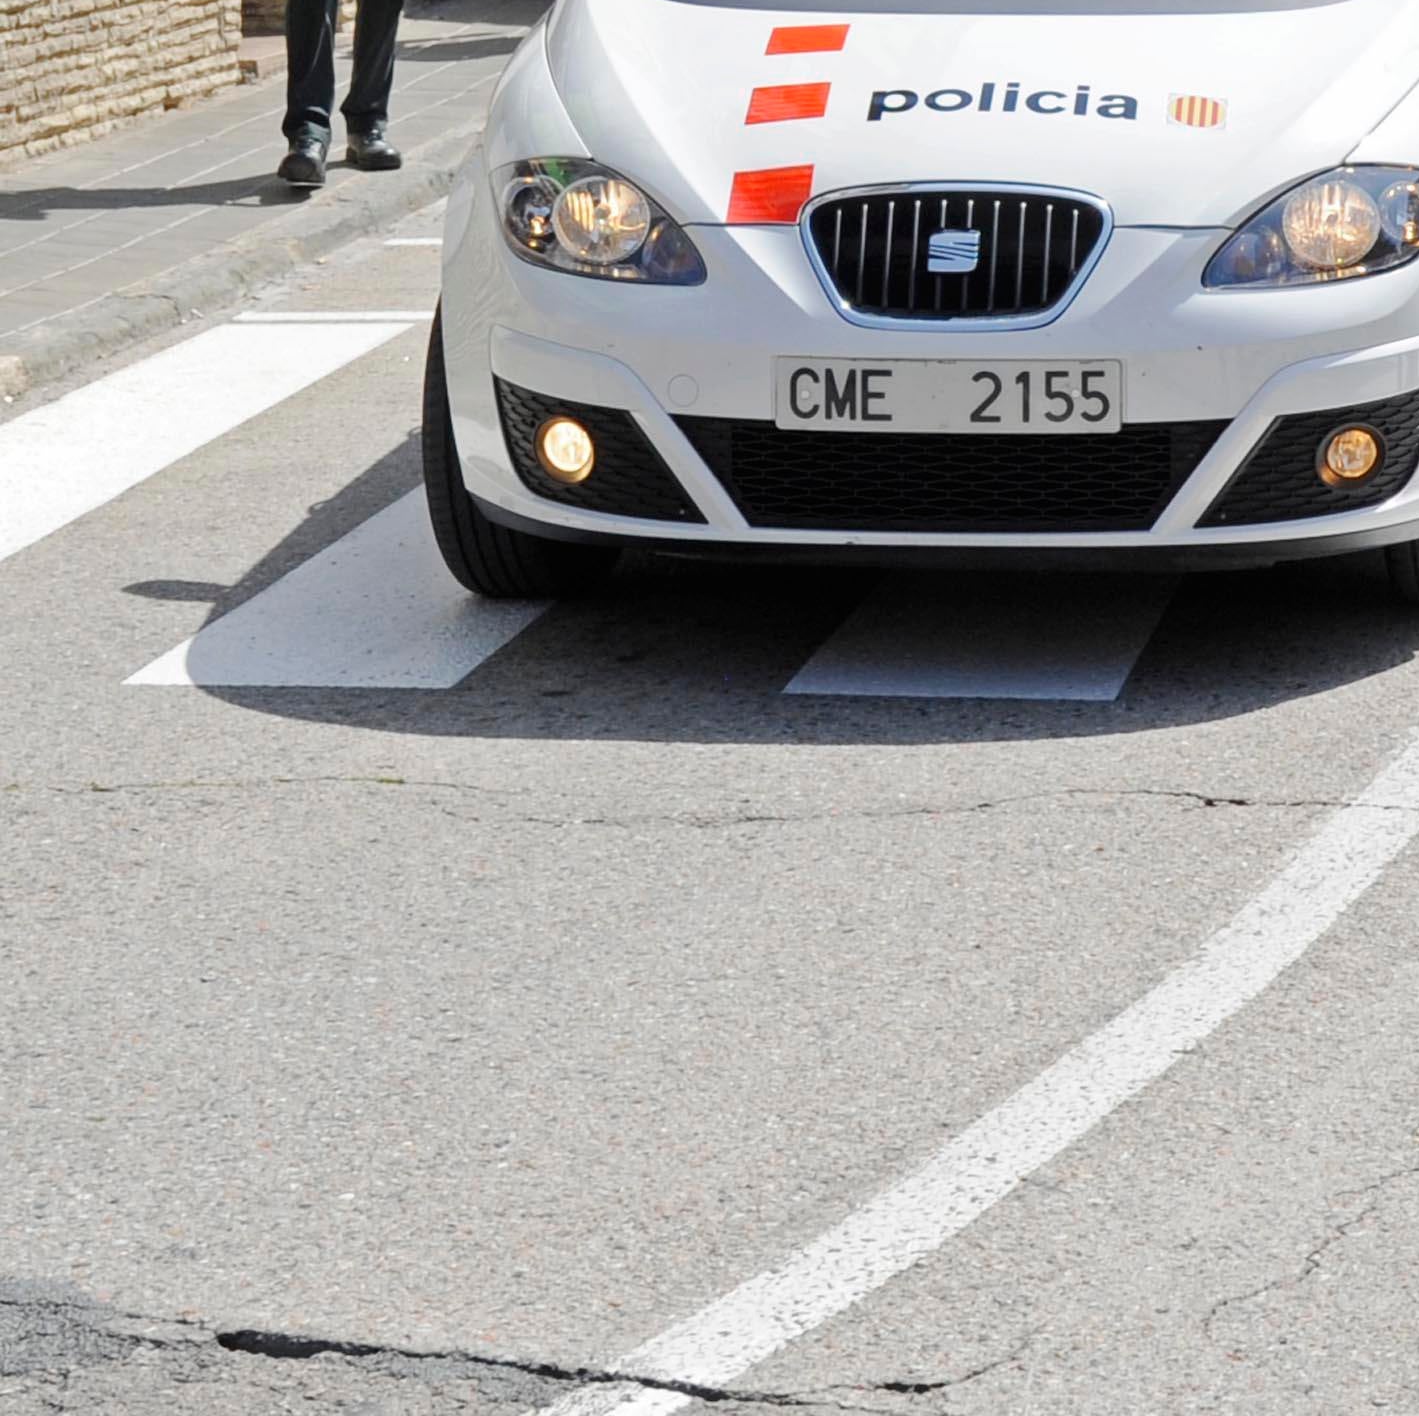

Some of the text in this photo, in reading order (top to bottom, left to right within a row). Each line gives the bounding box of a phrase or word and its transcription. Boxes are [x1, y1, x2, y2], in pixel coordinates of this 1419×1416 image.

[867, 82, 1138, 122] policia
[789, 367, 1111, 423] CME 2155
